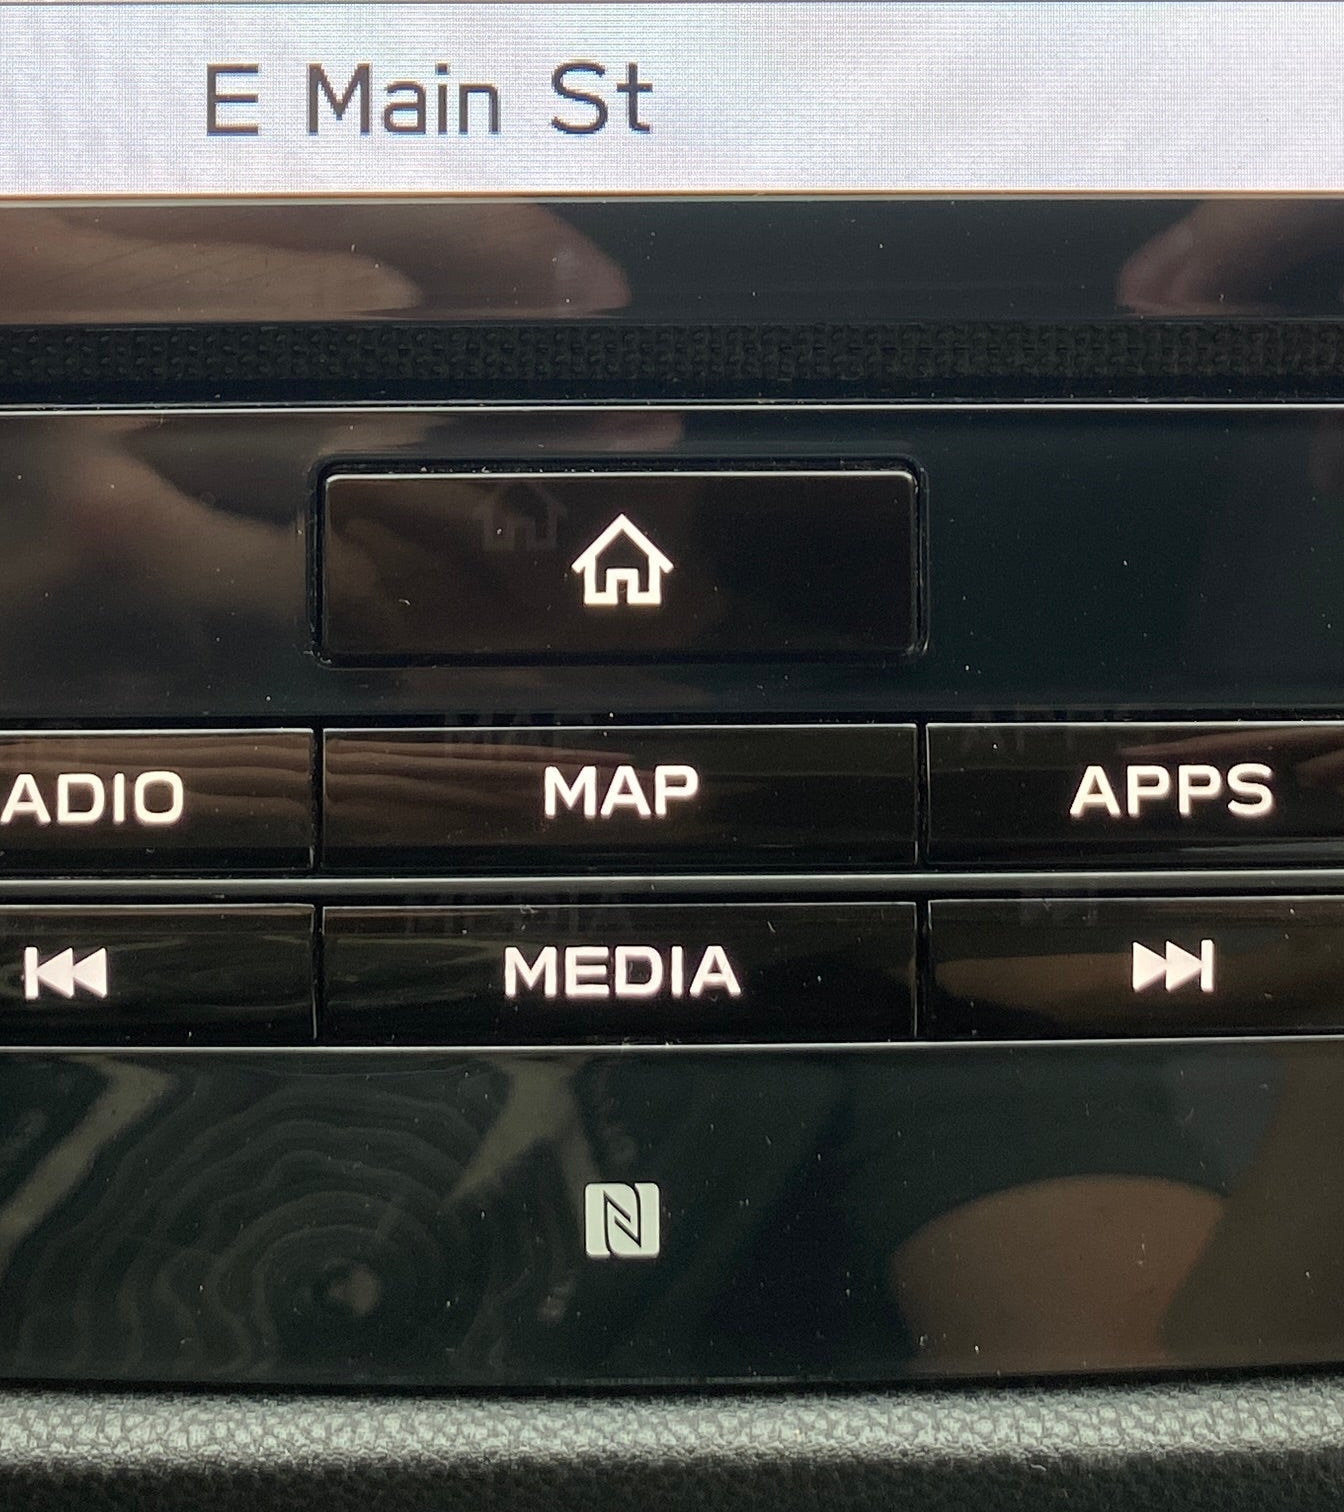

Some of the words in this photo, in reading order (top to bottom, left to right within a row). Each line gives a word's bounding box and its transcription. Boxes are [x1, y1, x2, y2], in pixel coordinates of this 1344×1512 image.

[206, 64, 260, 137] E
[307, 63, 501, 136] Main
[550, 61, 653, 136] St
[544, 765, 699, 818] MAP
[1069, 763, 1273, 817] APPS
[504, 945, 742, 998] MEDIA
